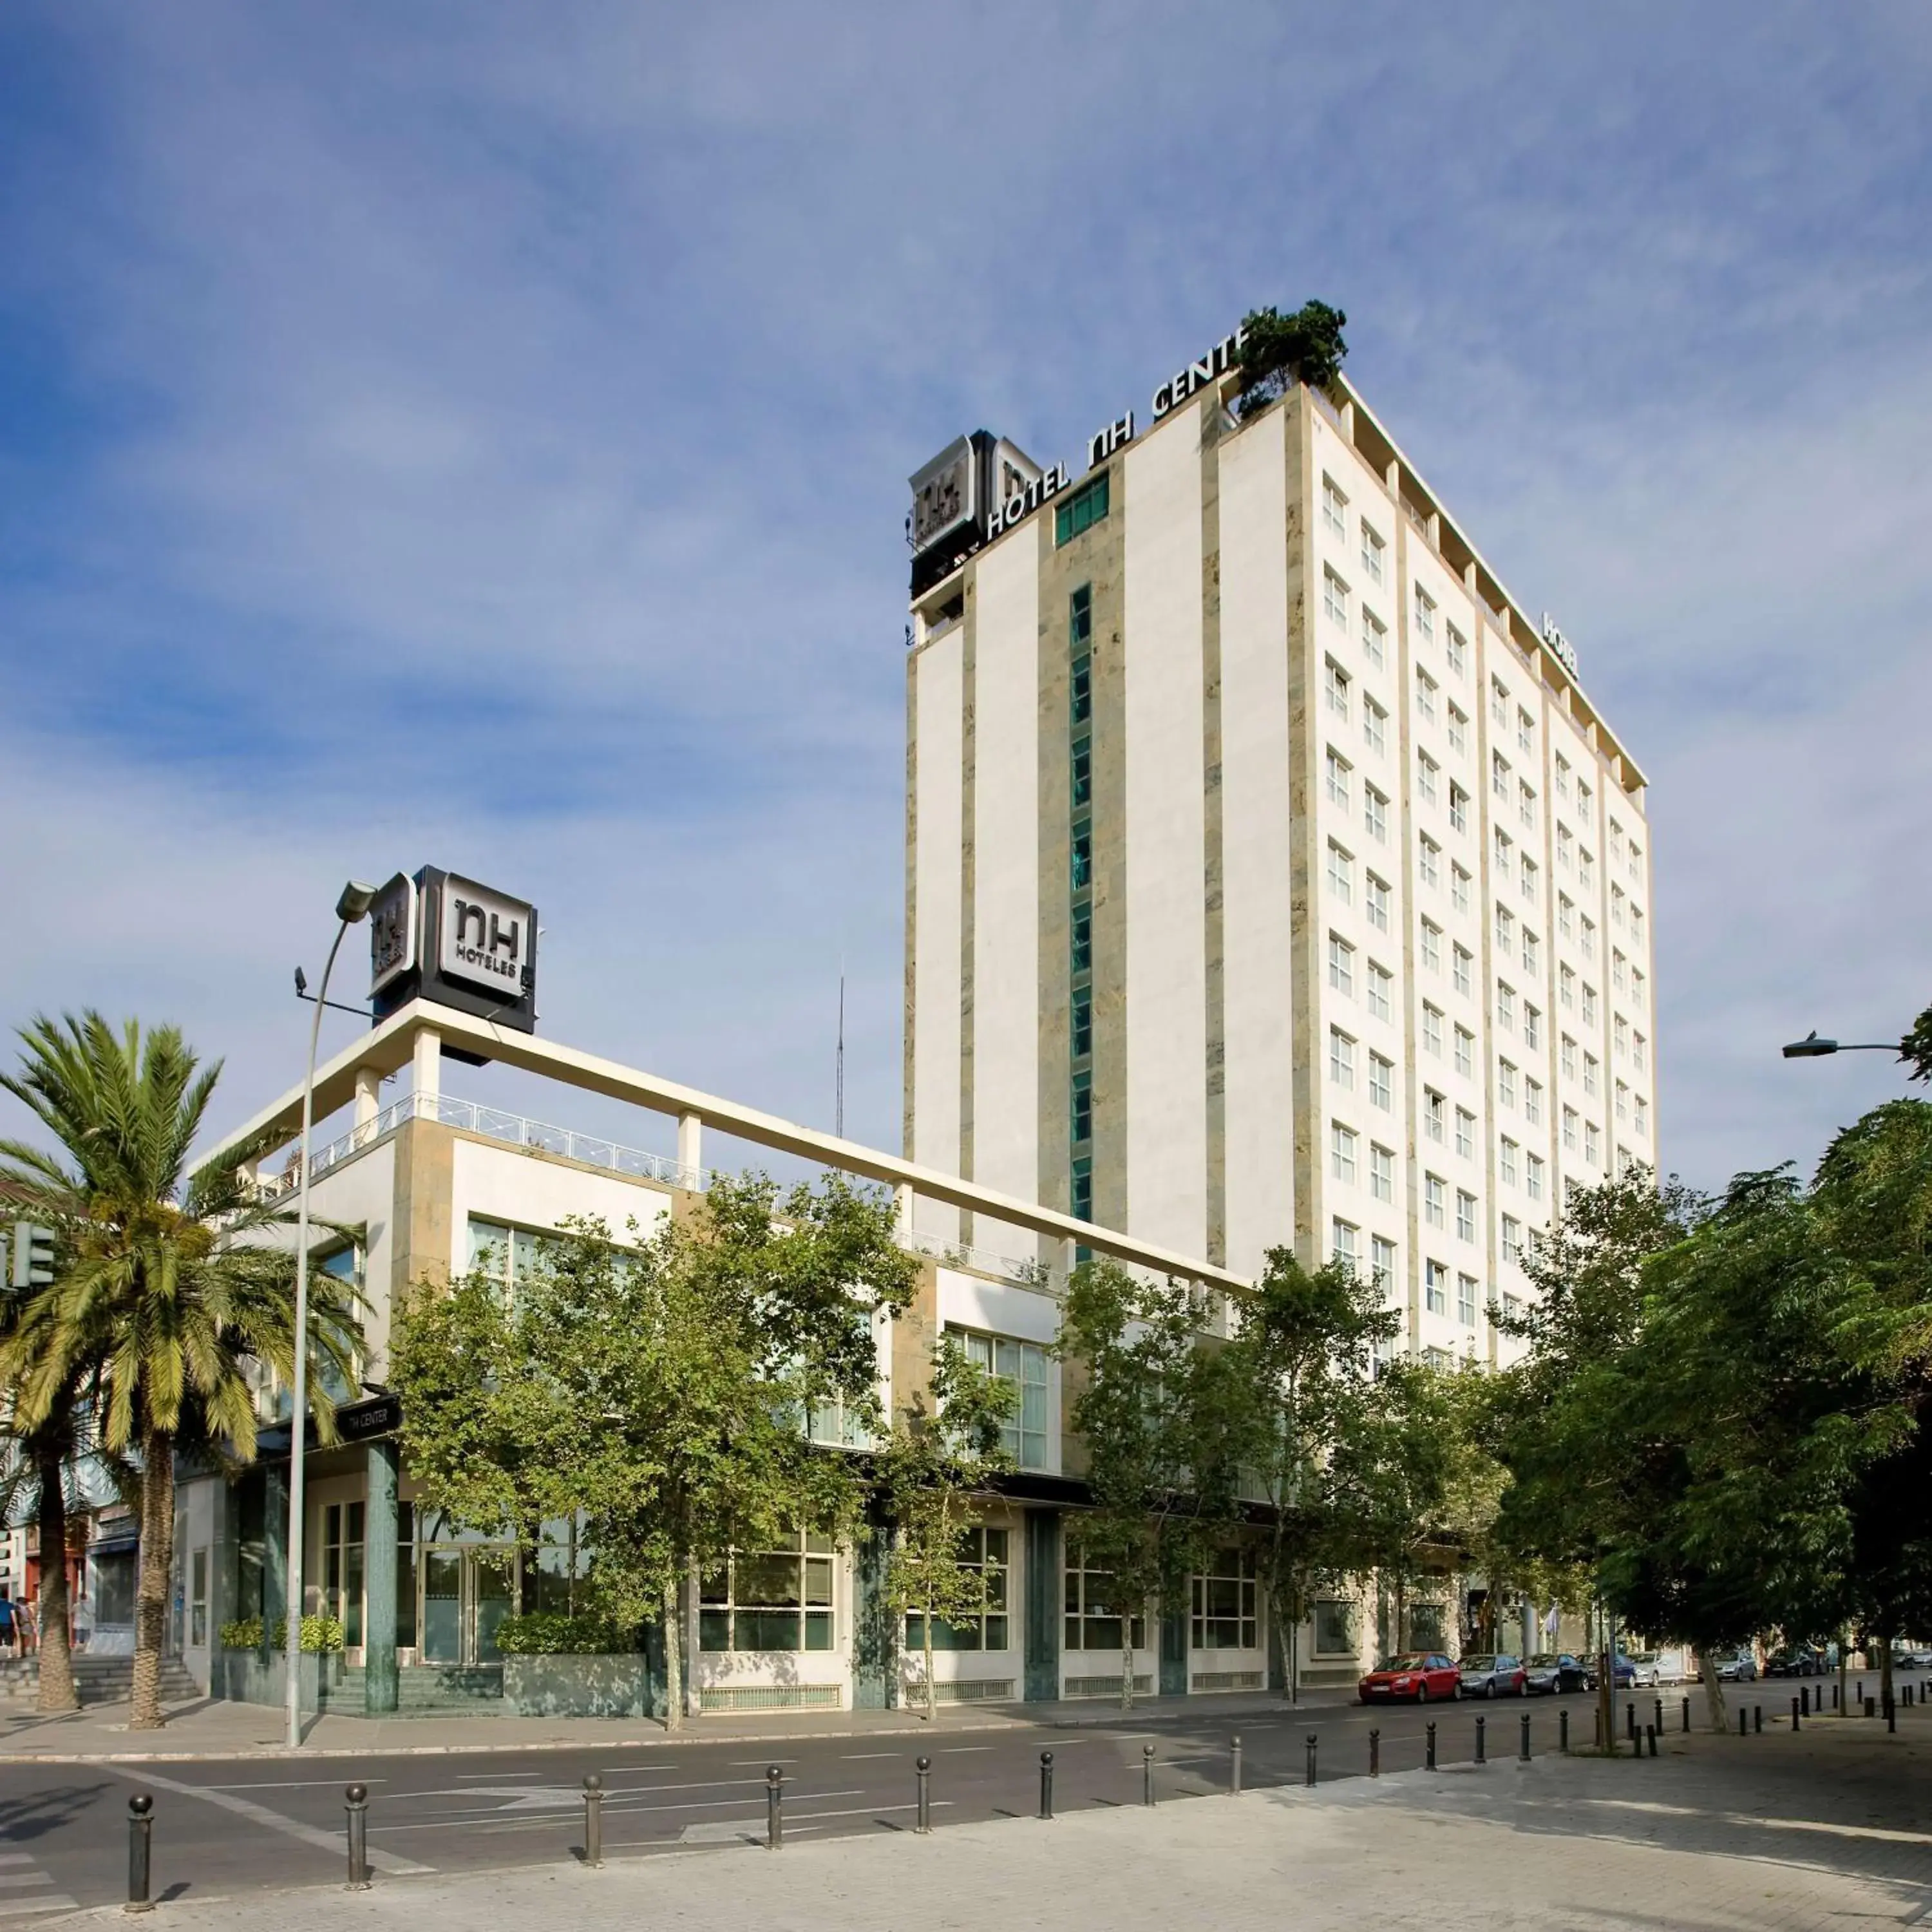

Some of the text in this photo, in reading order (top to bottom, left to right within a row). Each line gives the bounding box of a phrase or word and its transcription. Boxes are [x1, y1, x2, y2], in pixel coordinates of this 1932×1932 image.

[987, 460, 1070, 541] HOTEL
[456, 943, 516, 978] HOTELES
[360, 1408, 388, 1427] CENTER
